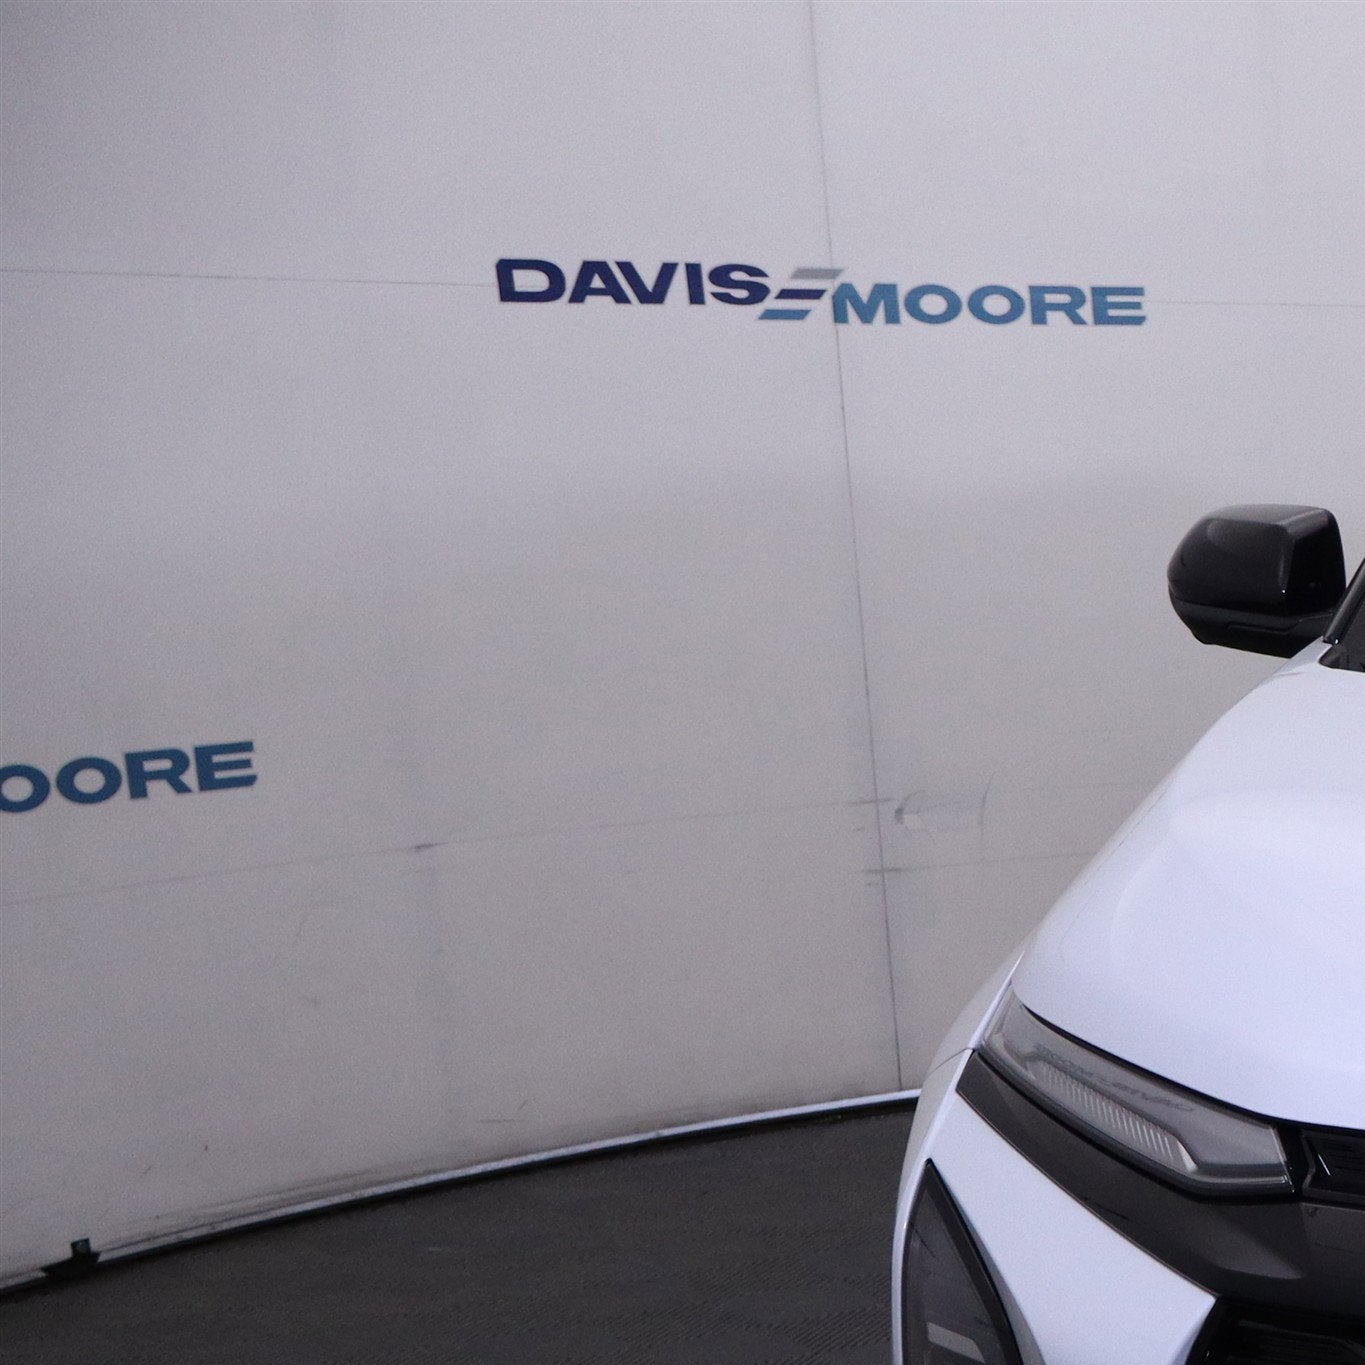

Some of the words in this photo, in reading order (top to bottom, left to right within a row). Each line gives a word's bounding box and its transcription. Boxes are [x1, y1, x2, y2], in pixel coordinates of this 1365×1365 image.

[497, 258, 770, 305] DAVIS
[831, 281, 1148, 326] MOORE
[0, 741, 258, 813] OORE
